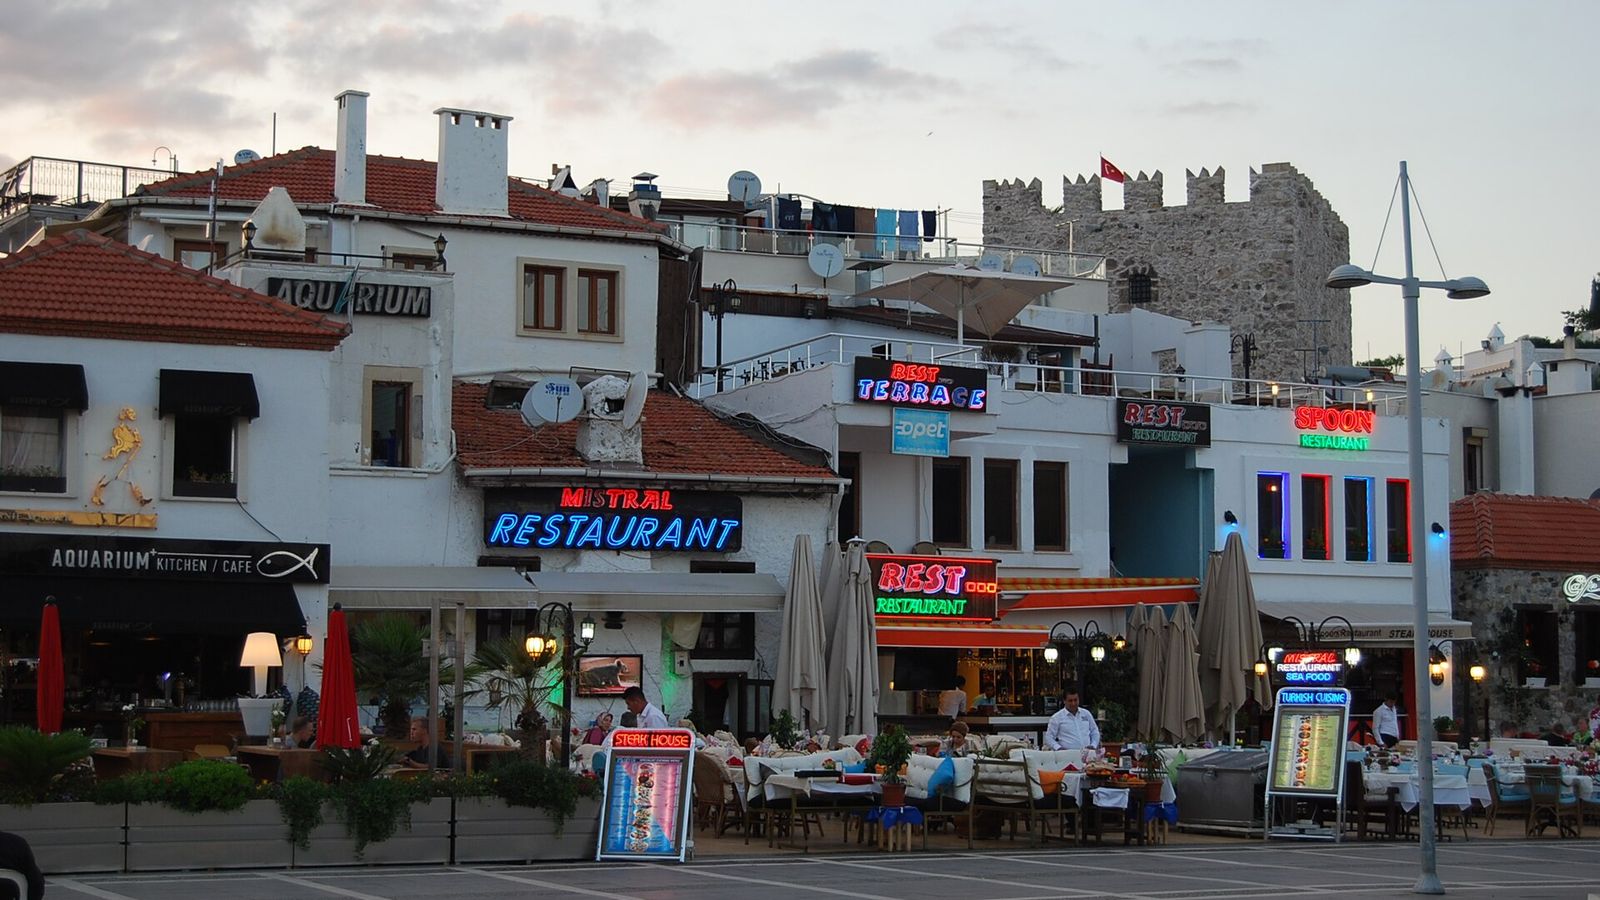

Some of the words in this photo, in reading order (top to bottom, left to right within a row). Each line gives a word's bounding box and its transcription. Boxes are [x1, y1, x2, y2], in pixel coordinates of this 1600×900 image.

[277, 269, 429, 320] AQUARIUM
[890, 363, 940, 383] REST
[858, 379, 986, 409] TERRACE
[1124, 403, 1186, 429] REST
[1294, 405, 1375, 433] SPOON
[1132, 428, 1198, 443] RESTAURANT
[1302, 434, 1369, 450] RESTAURANT
[560, 487, 673, 510] MISTRAL
[490, 513, 739, 549] RESTAURANT
[156, 559, 207, 573] KITCHEN
[223, 560, 252, 574] CAFE
[878, 562, 966, 595] REST
[876, 597, 967, 614] RESTAURANT
[1388, 629, 1415, 639] STEA
[1427, 629, 1454, 639] OUSE
[1276, 663, 1342, 672] RESTAURANT
[1285, 672, 1304, 681] SEA
[1305, 672, 1331, 681] FOOD
[1281, 692, 1314, 703] TURKISH
[1315, 692, 1346, 703] CUISINE
[615, 733, 649, 747] STEAK
[650, 734, 690, 747] HOUSE
